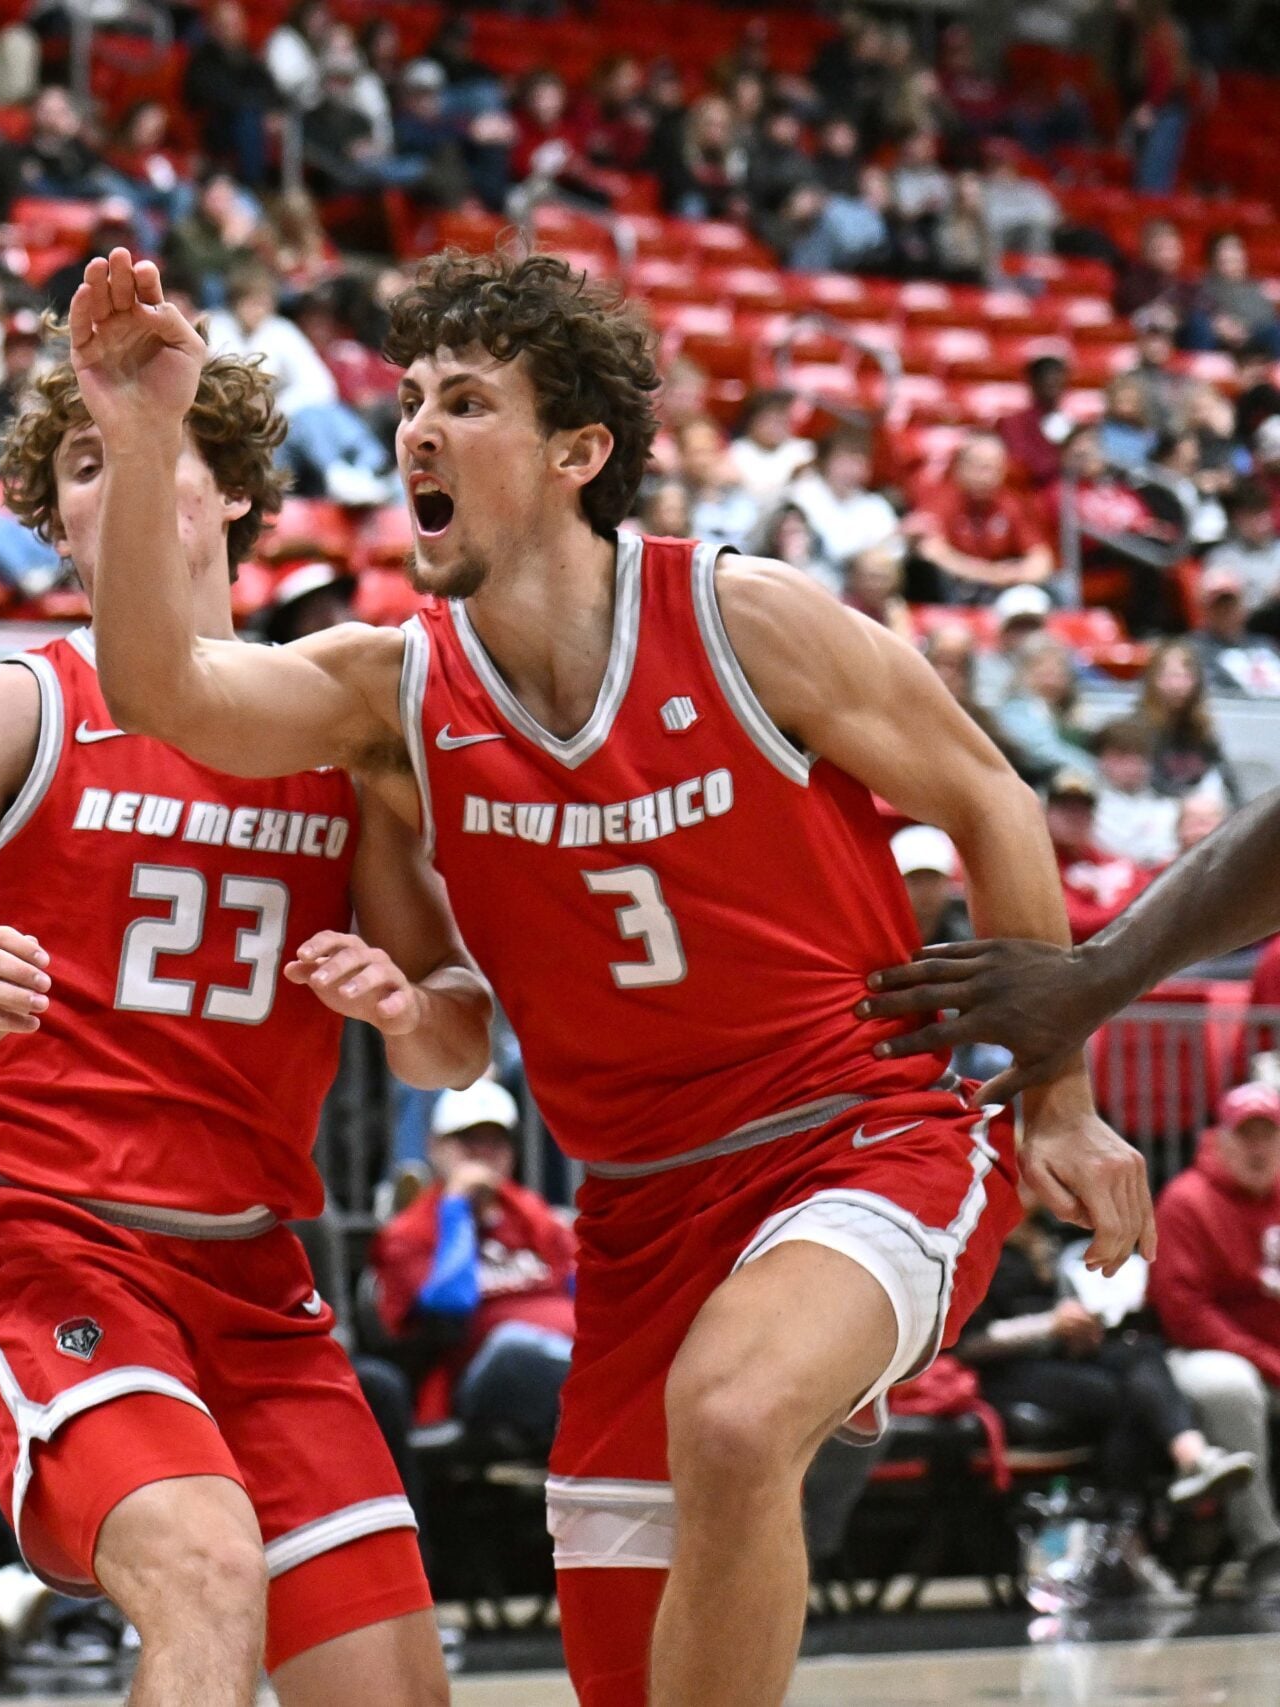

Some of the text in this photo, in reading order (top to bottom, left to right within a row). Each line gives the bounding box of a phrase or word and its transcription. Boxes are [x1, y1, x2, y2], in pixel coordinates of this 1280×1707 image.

[72, 786, 350, 860] NEW MEXICO
[462, 767, 734, 848] NEW MEXICO
[113, 862, 291, 1026] 23
[579, 864, 688, 989] 3
